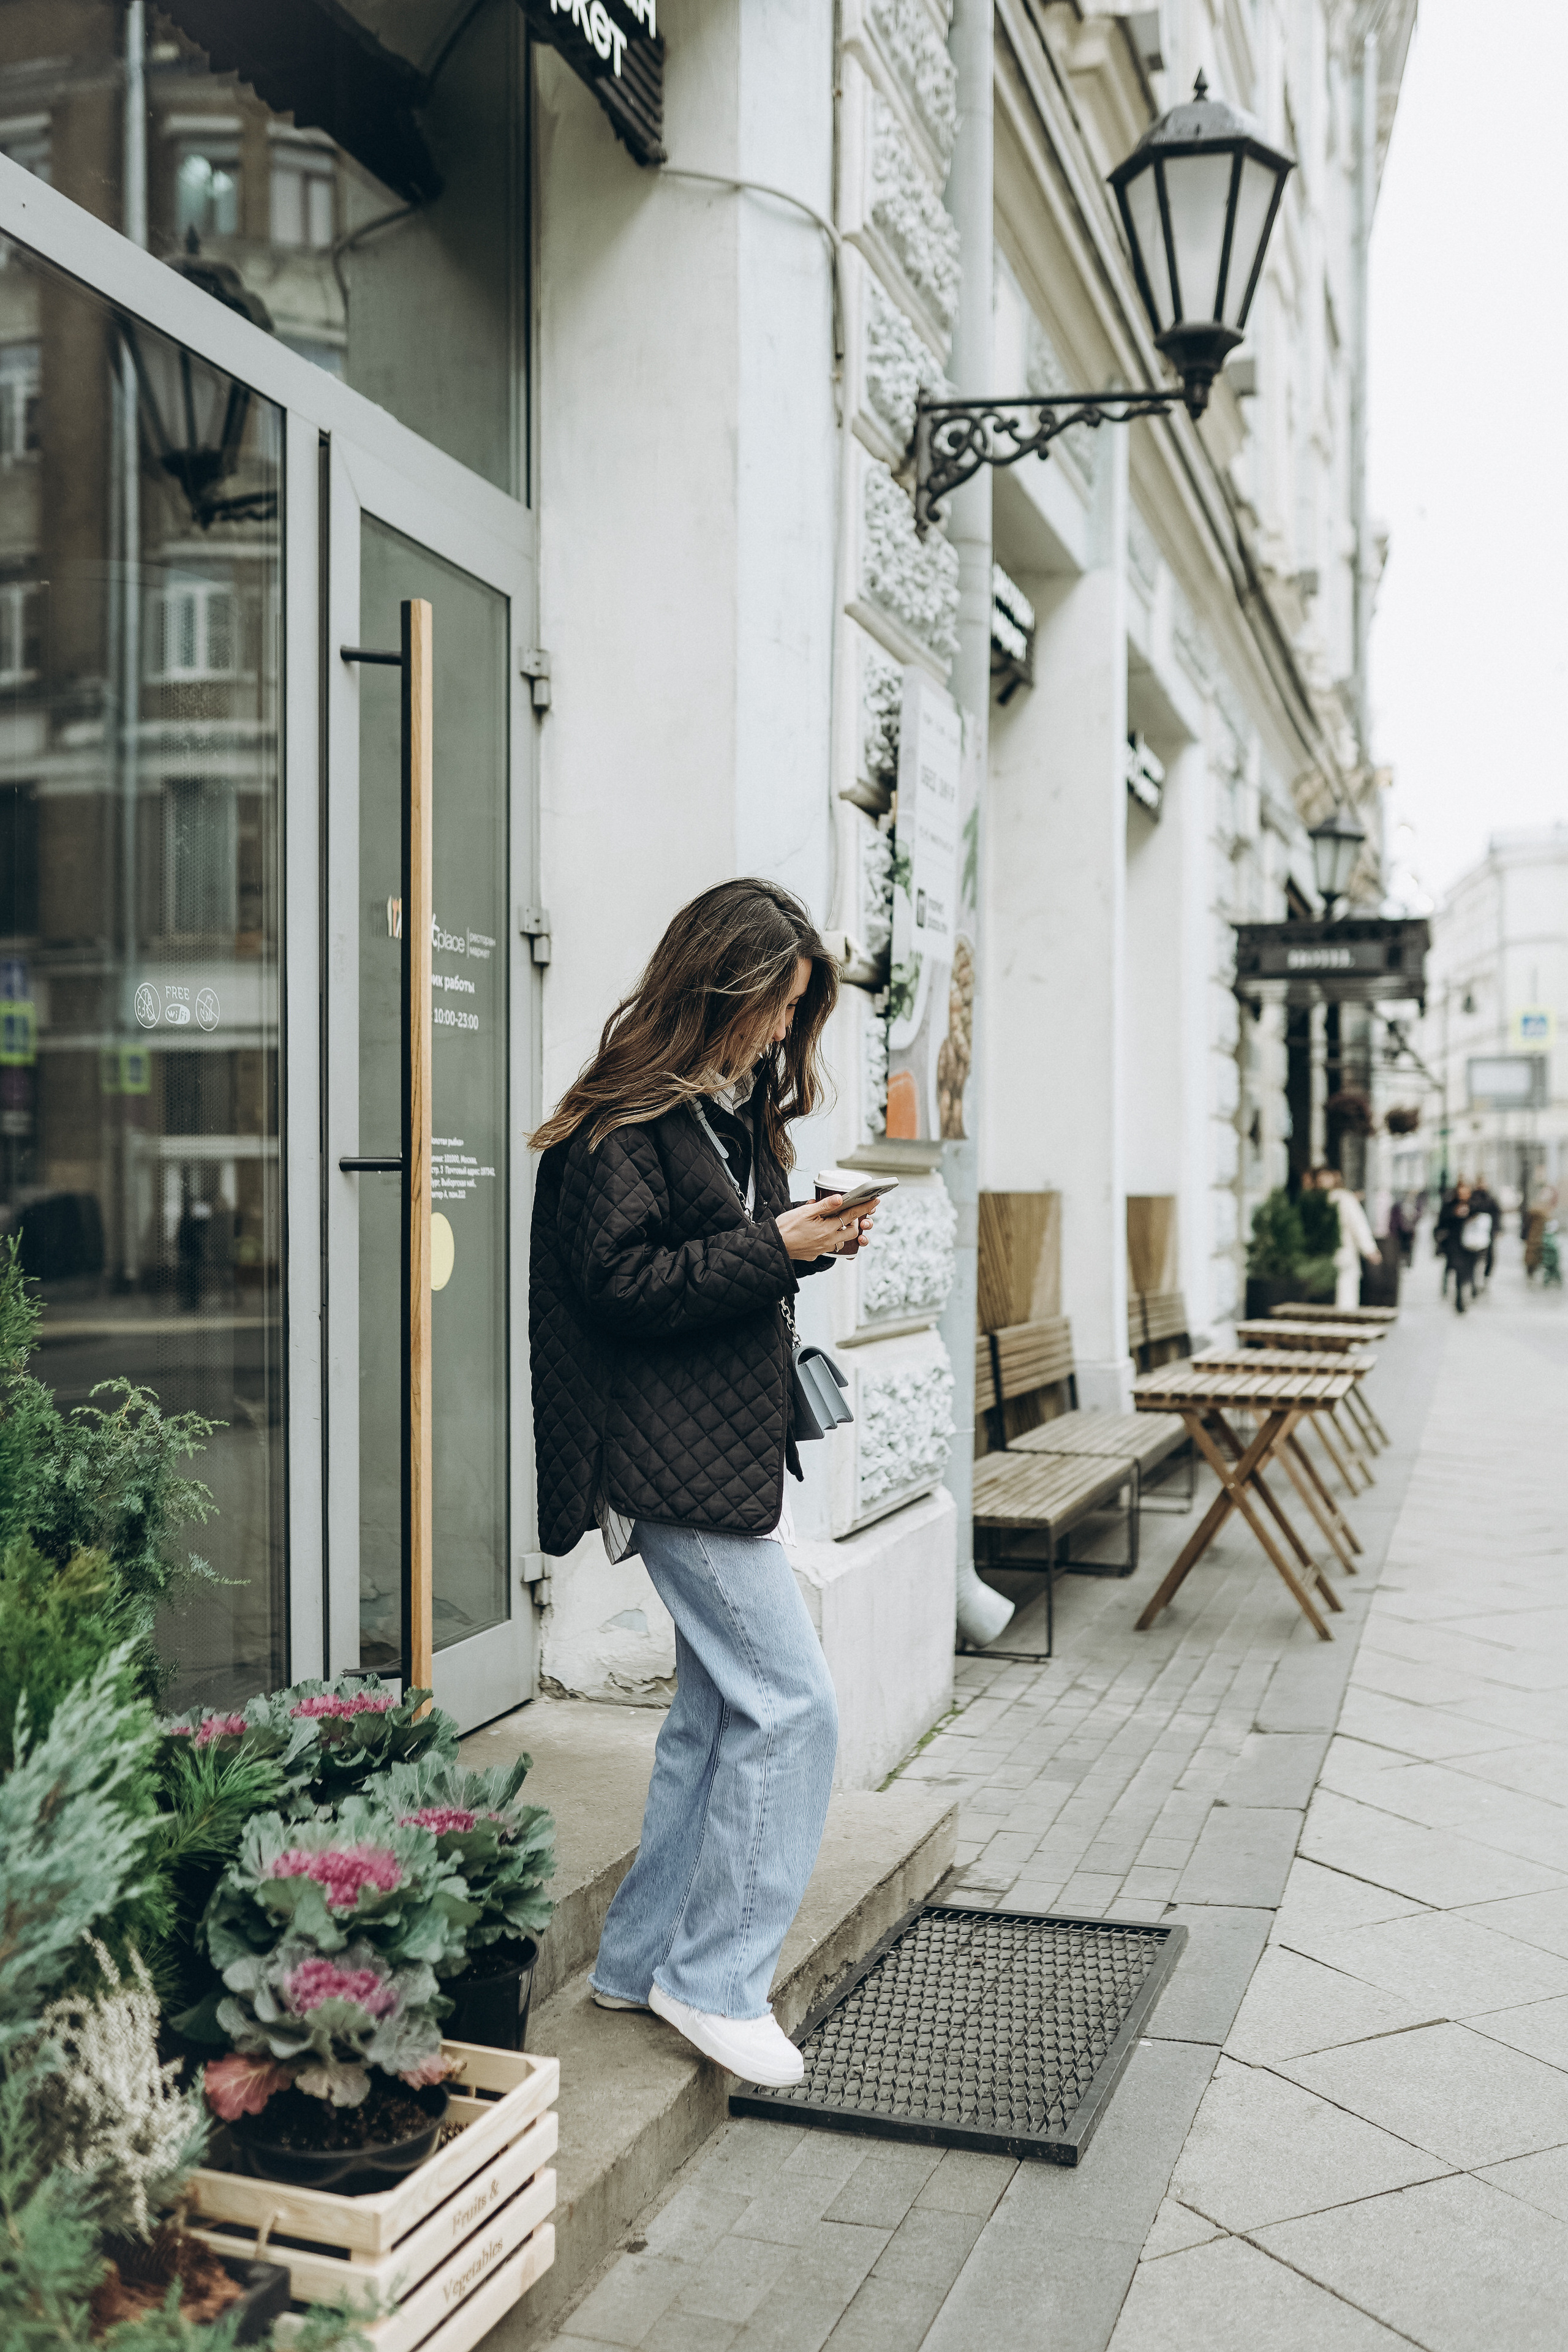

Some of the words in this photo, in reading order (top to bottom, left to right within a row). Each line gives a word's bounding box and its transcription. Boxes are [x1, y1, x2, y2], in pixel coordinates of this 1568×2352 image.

[165, 986, 190, 1000] FREE
[444, 974, 475, 994] работы
[434, 1008, 479, 1030] 10:00-23:00
[452, 2195, 486, 2236] Fruits
[489, 2179, 499, 2201] &
[443, 2239, 503, 2304] Vegetables
